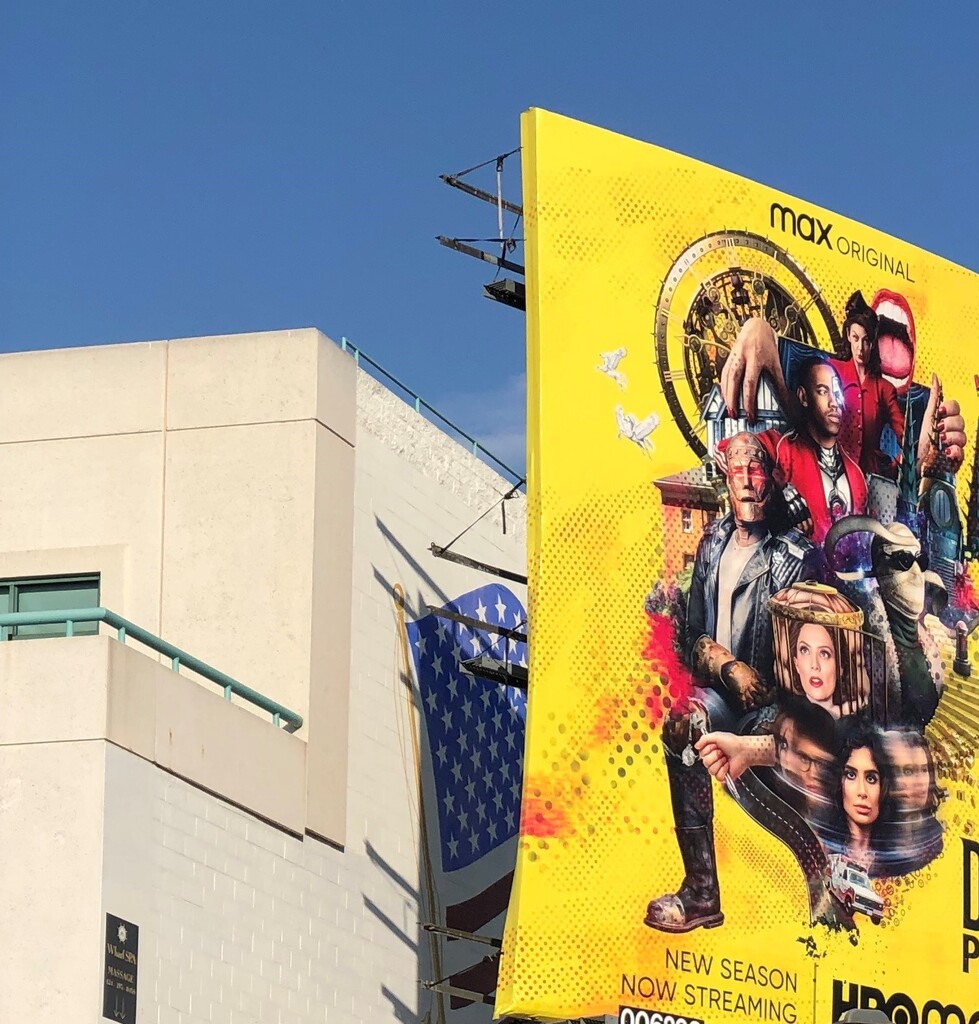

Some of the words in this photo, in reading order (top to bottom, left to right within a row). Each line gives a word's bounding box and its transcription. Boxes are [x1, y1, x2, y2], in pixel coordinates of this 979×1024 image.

[770, 203, 833, 250] max
[837, 236, 915, 283] ORIGINAL
[665, 947, 713, 975] NEW
[720, 958, 798, 993] SEASON
[621, 973, 677, 1001] NOW
[684, 984, 798, 1024] STREAMING
